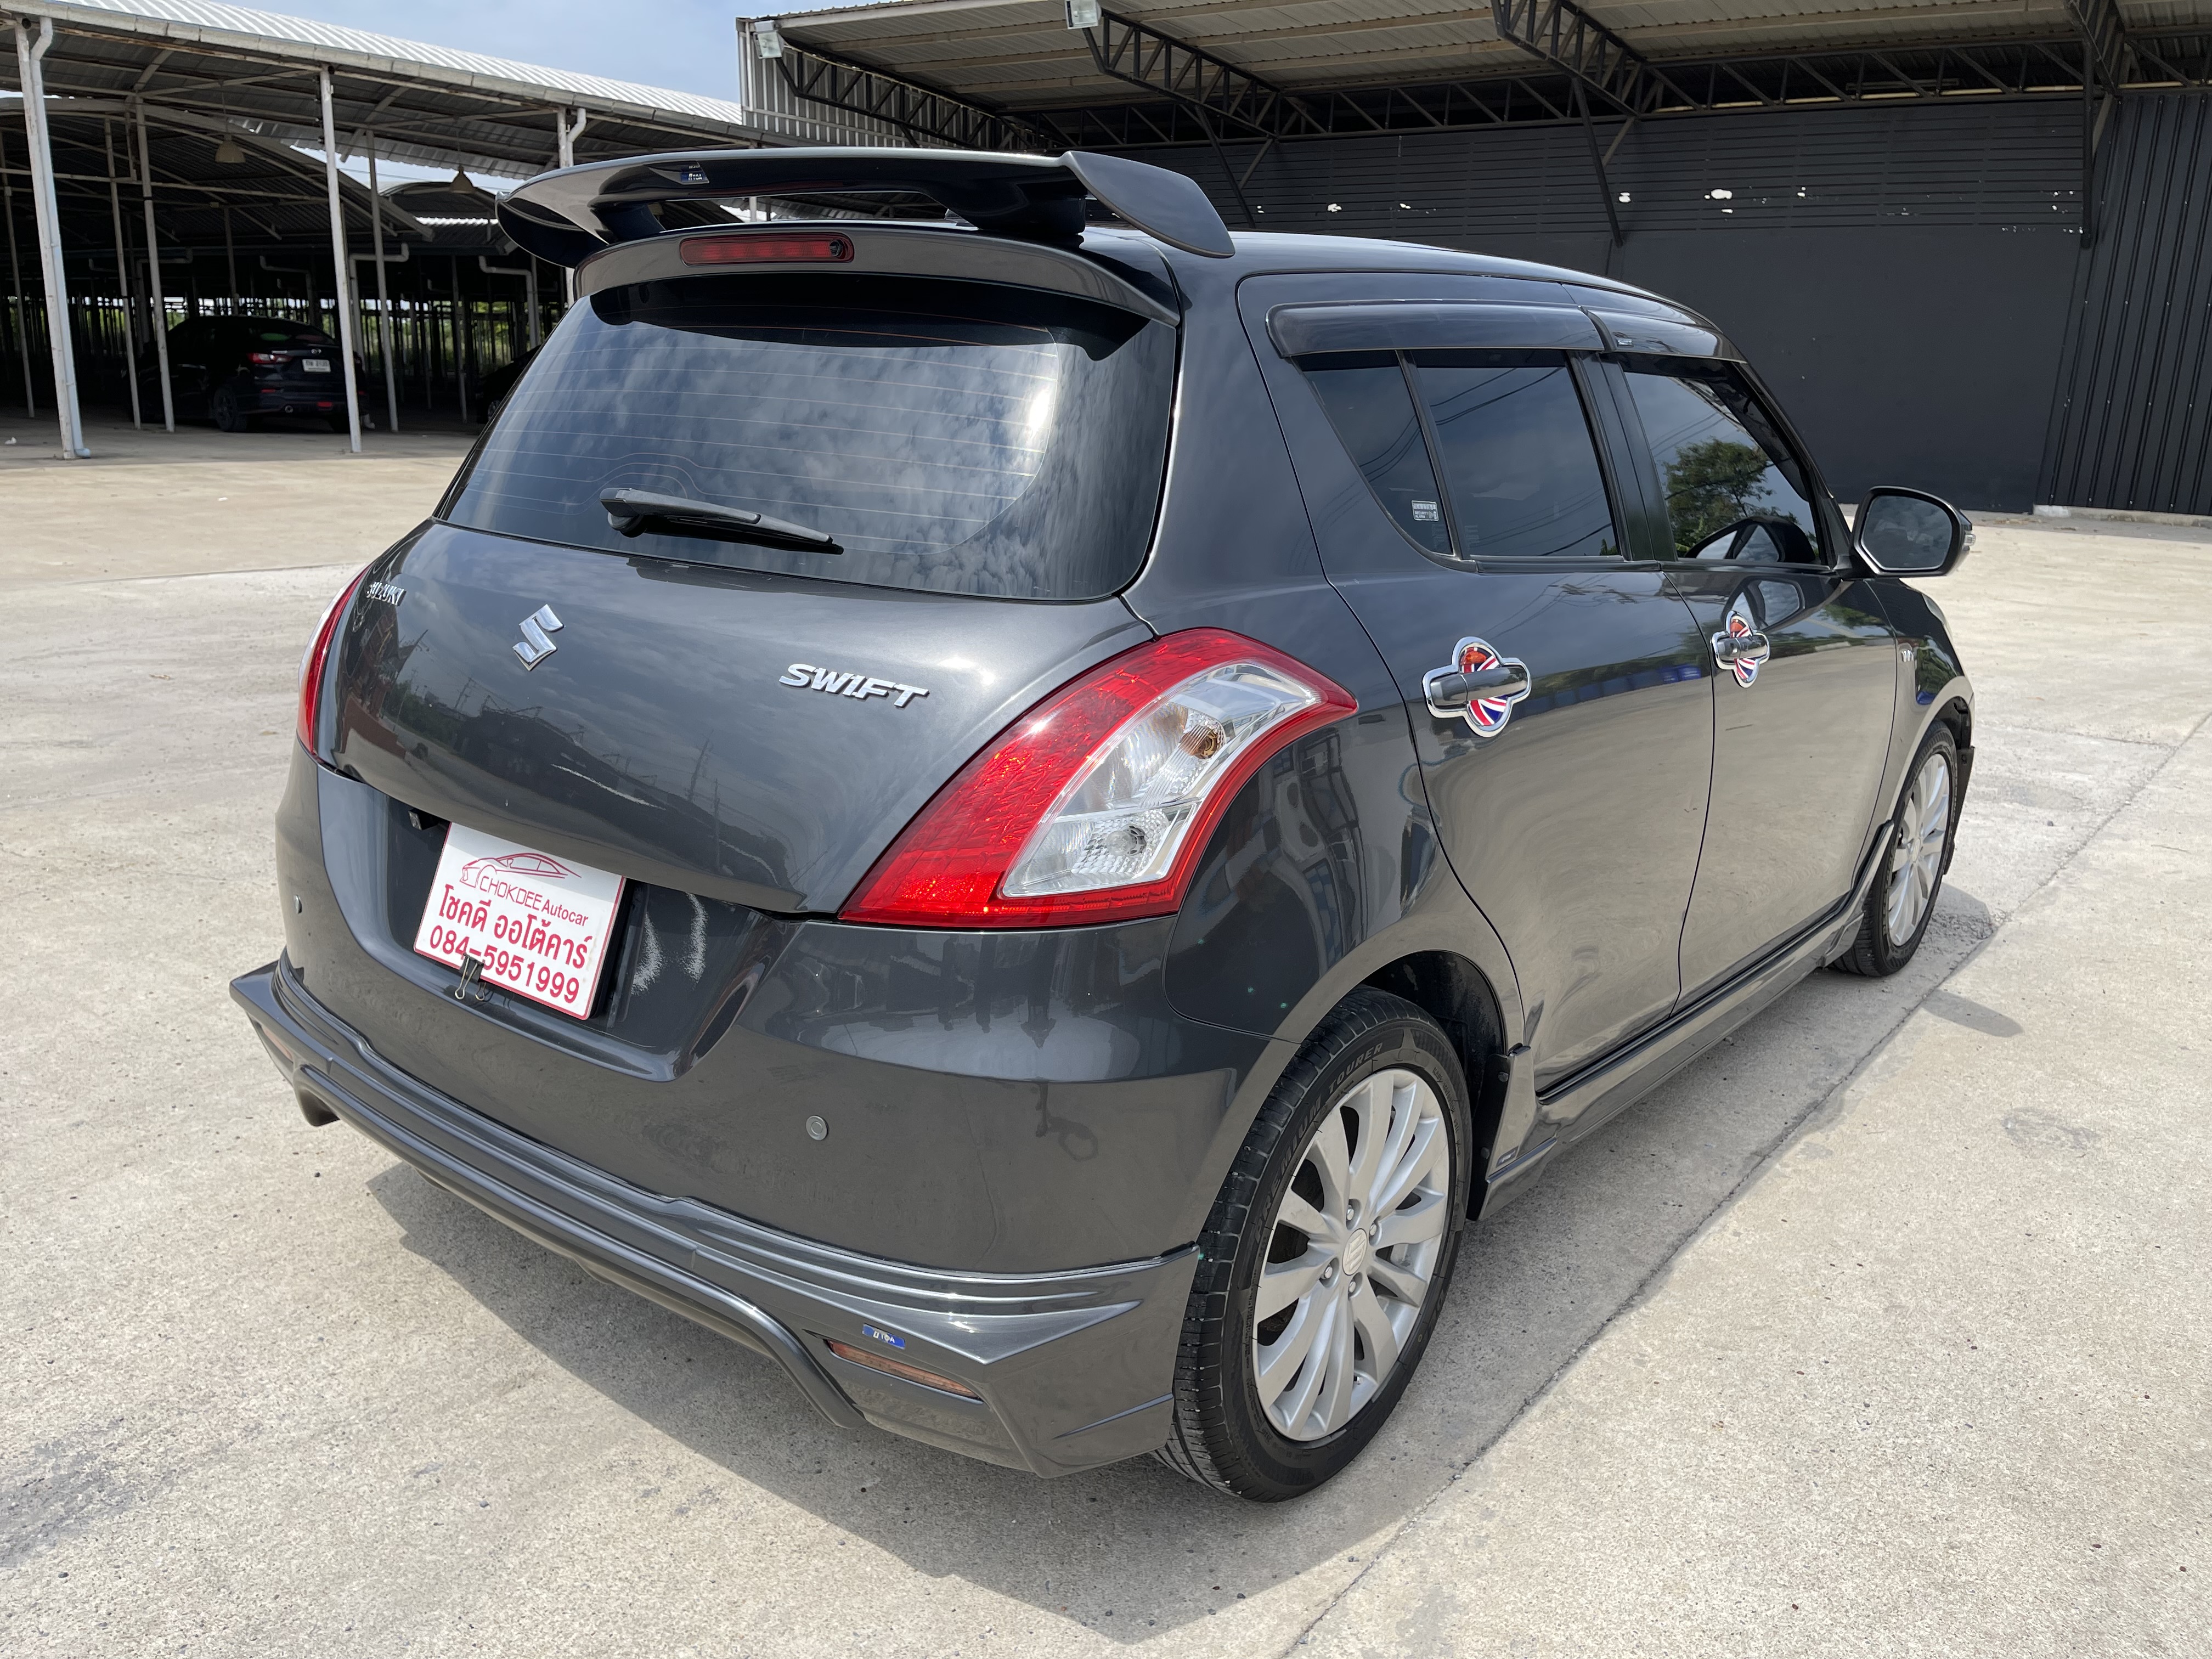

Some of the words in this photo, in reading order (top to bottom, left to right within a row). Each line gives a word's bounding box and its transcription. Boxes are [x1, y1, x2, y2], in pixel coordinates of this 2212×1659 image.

[778, 663, 929, 707] SWIFT
[439, 884, 492, 932] โชคดี
[495, 913, 592, 969] ออโต้คาร์
[479, 875, 543, 911] CHOKDEE
[541, 899, 589, 927] Autocar
[430, 925, 580, 1003] 084-5951999
[1255, 1095, 1321, 1244] PREMIUM
[1328, 1042, 1383, 1094] TOURER
